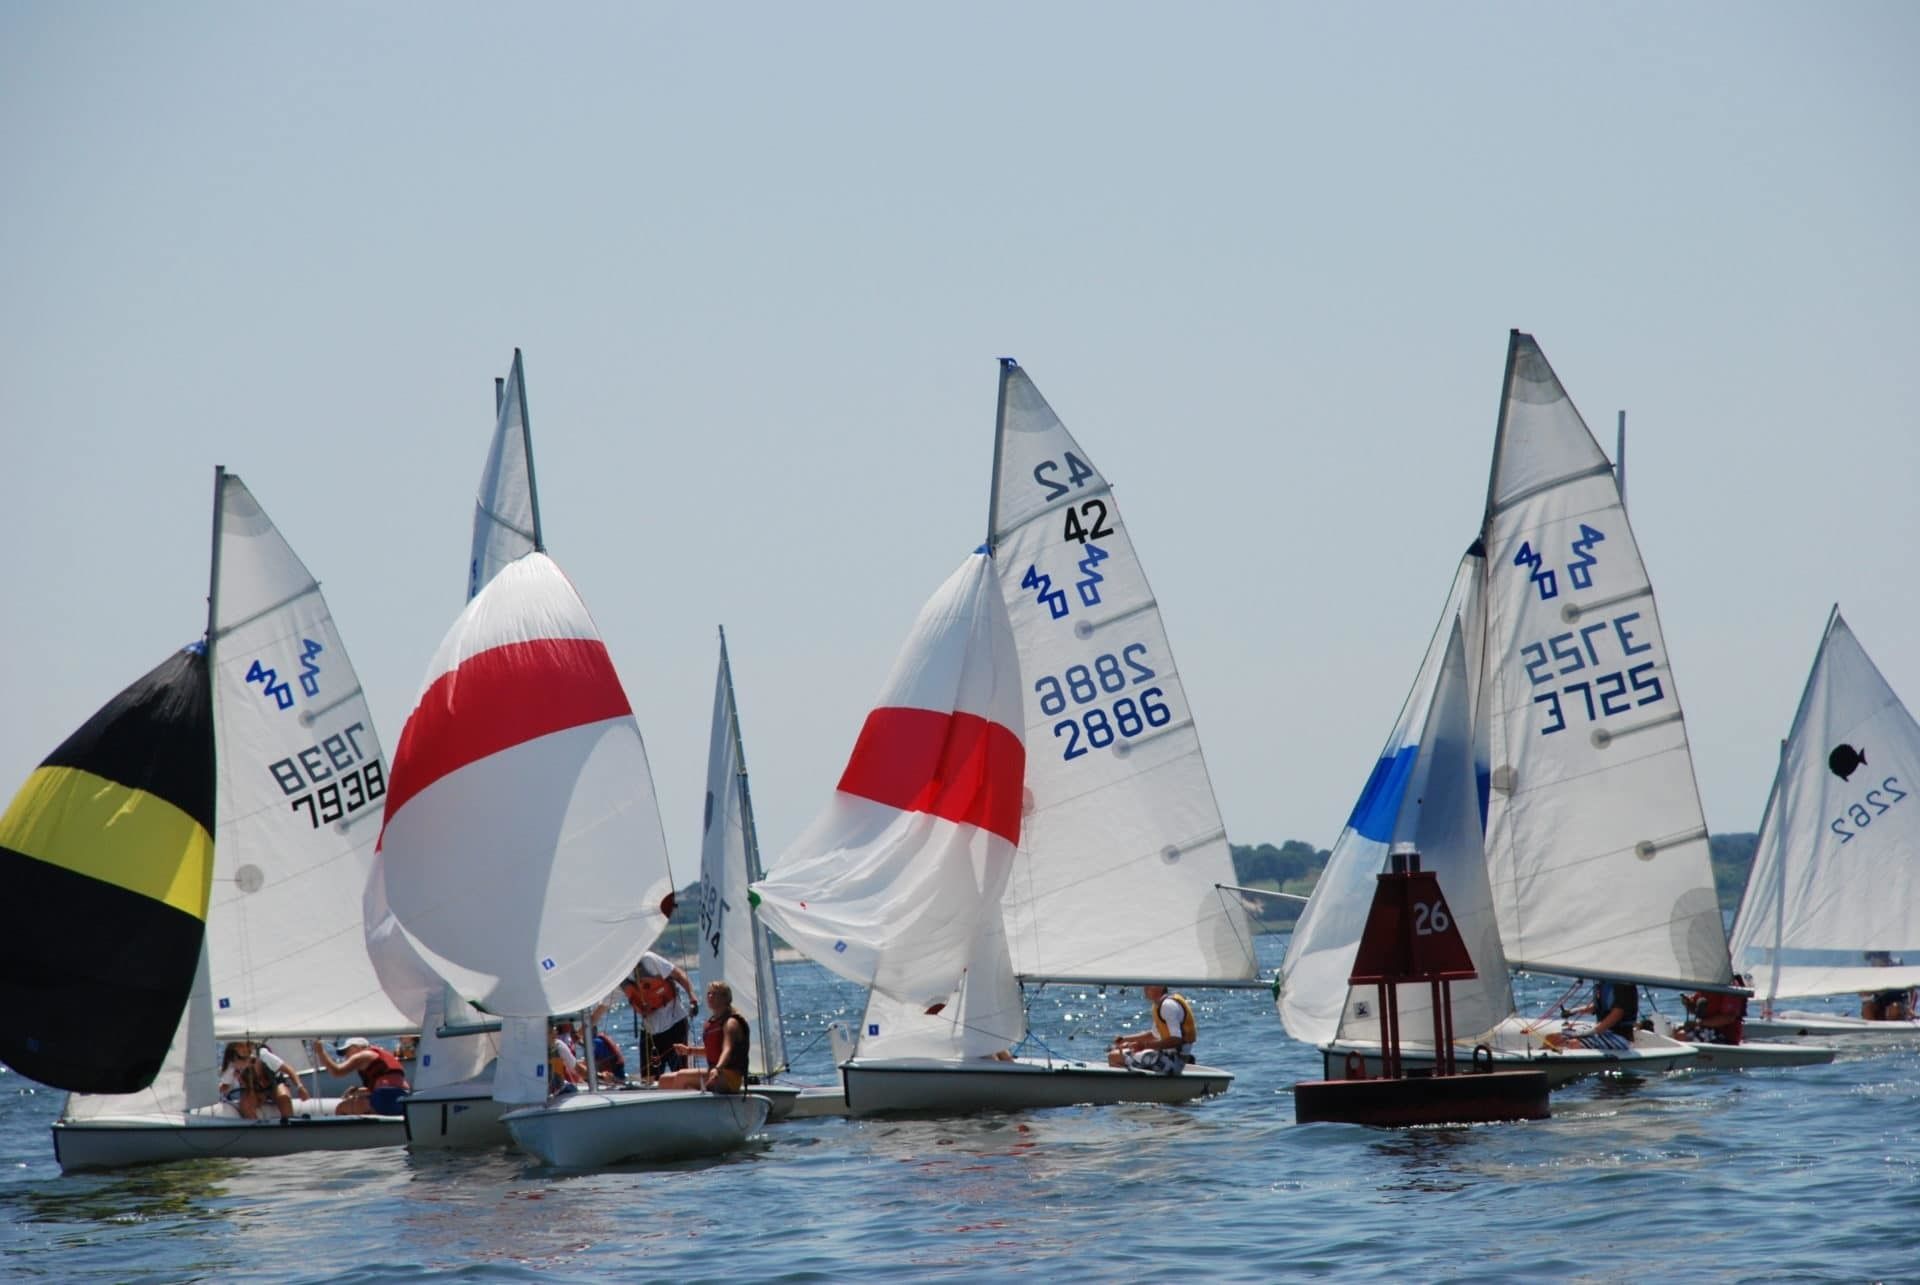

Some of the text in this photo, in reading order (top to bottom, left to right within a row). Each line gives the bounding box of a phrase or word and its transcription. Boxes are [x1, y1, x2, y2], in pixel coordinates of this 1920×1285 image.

[1063, 498, 1114, 544] 42
[1021, 564, 1069, 620] 420
[1514, 541, 1558, 600] 420
[245, 660, 294, 710] 420
[1534, 661, 1664, 735] 3725
[1053, 687, 1171, 761] 2886
[291, 759, 386, 829] 7938
[1413, 900, 1449, 936] 26
